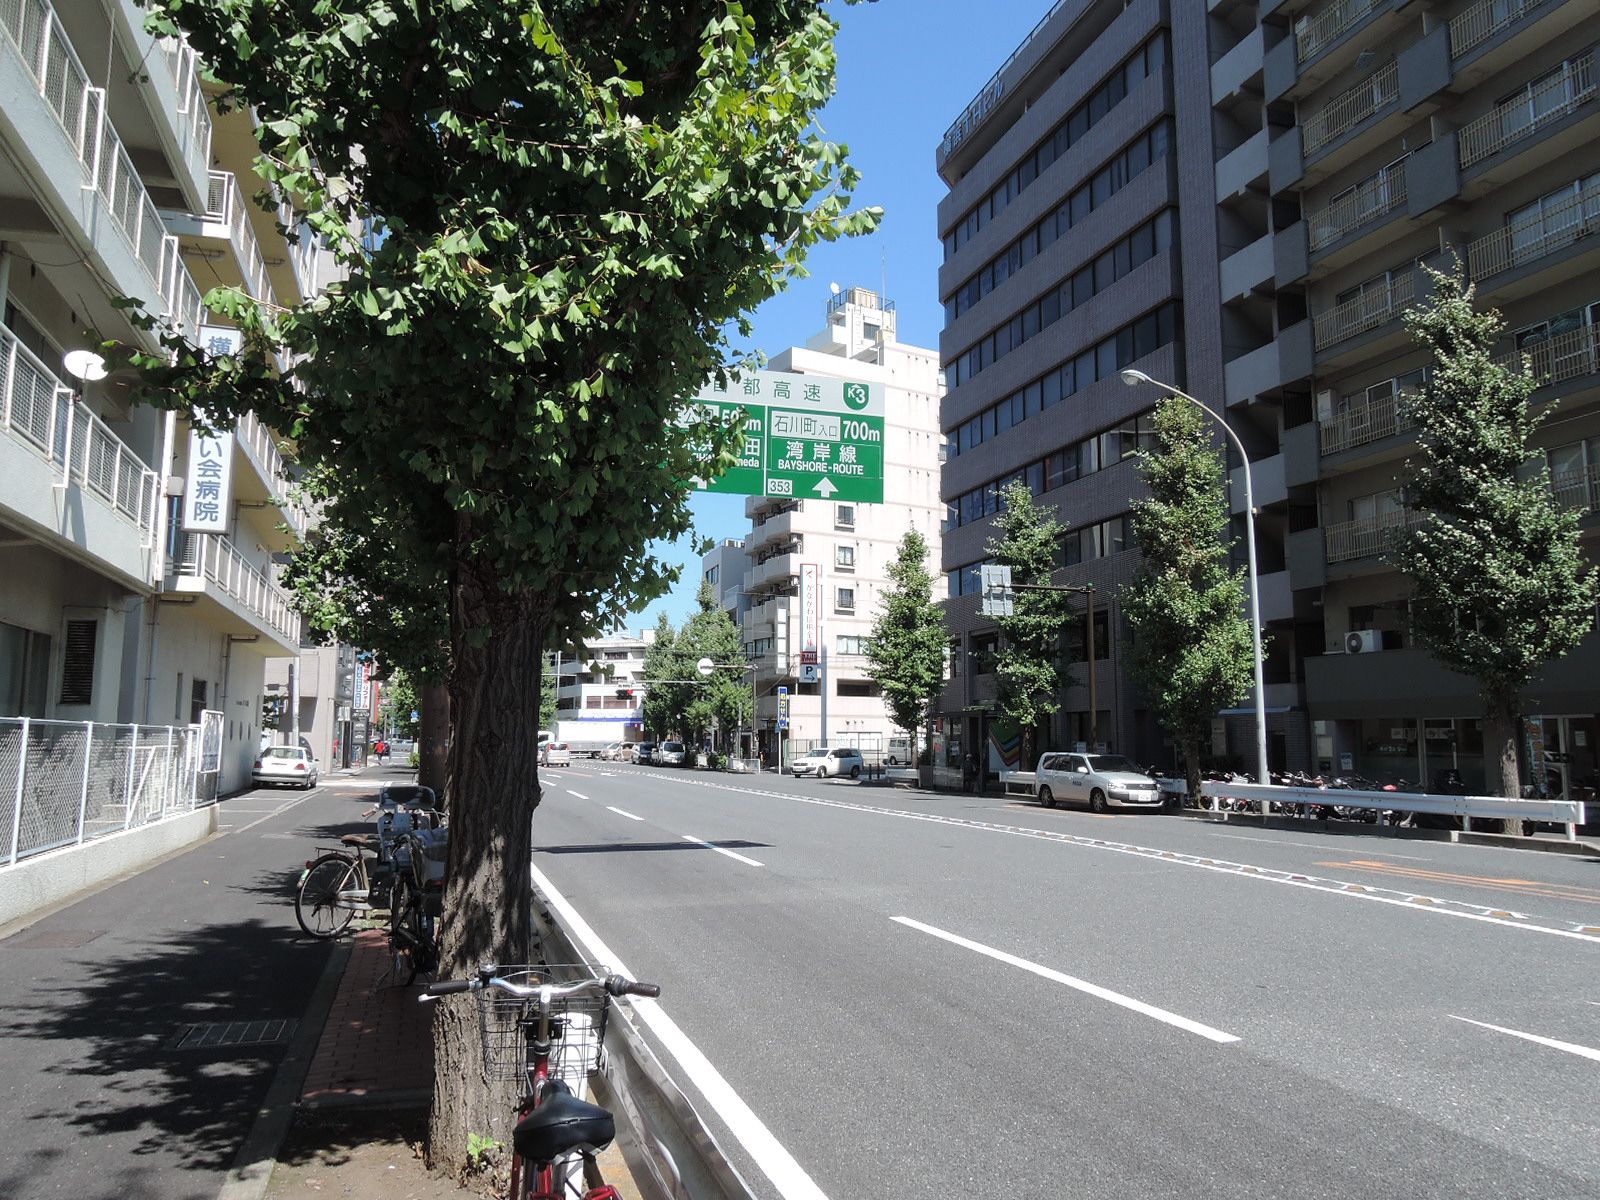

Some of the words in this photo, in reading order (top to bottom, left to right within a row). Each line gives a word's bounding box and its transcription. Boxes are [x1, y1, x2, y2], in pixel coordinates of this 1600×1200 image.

[722, 405, 762, 432] 50m
[774, 415, 838, 437] 石川町入口
[842, 420, 880, 442] 700m
[786, 441, 857, 464] 湾岸線
[778, 459, 864, 475] BAYSHORE-ROUTE
[770, 480, 790, 493] 353
[805, 666, 813, 675] P
